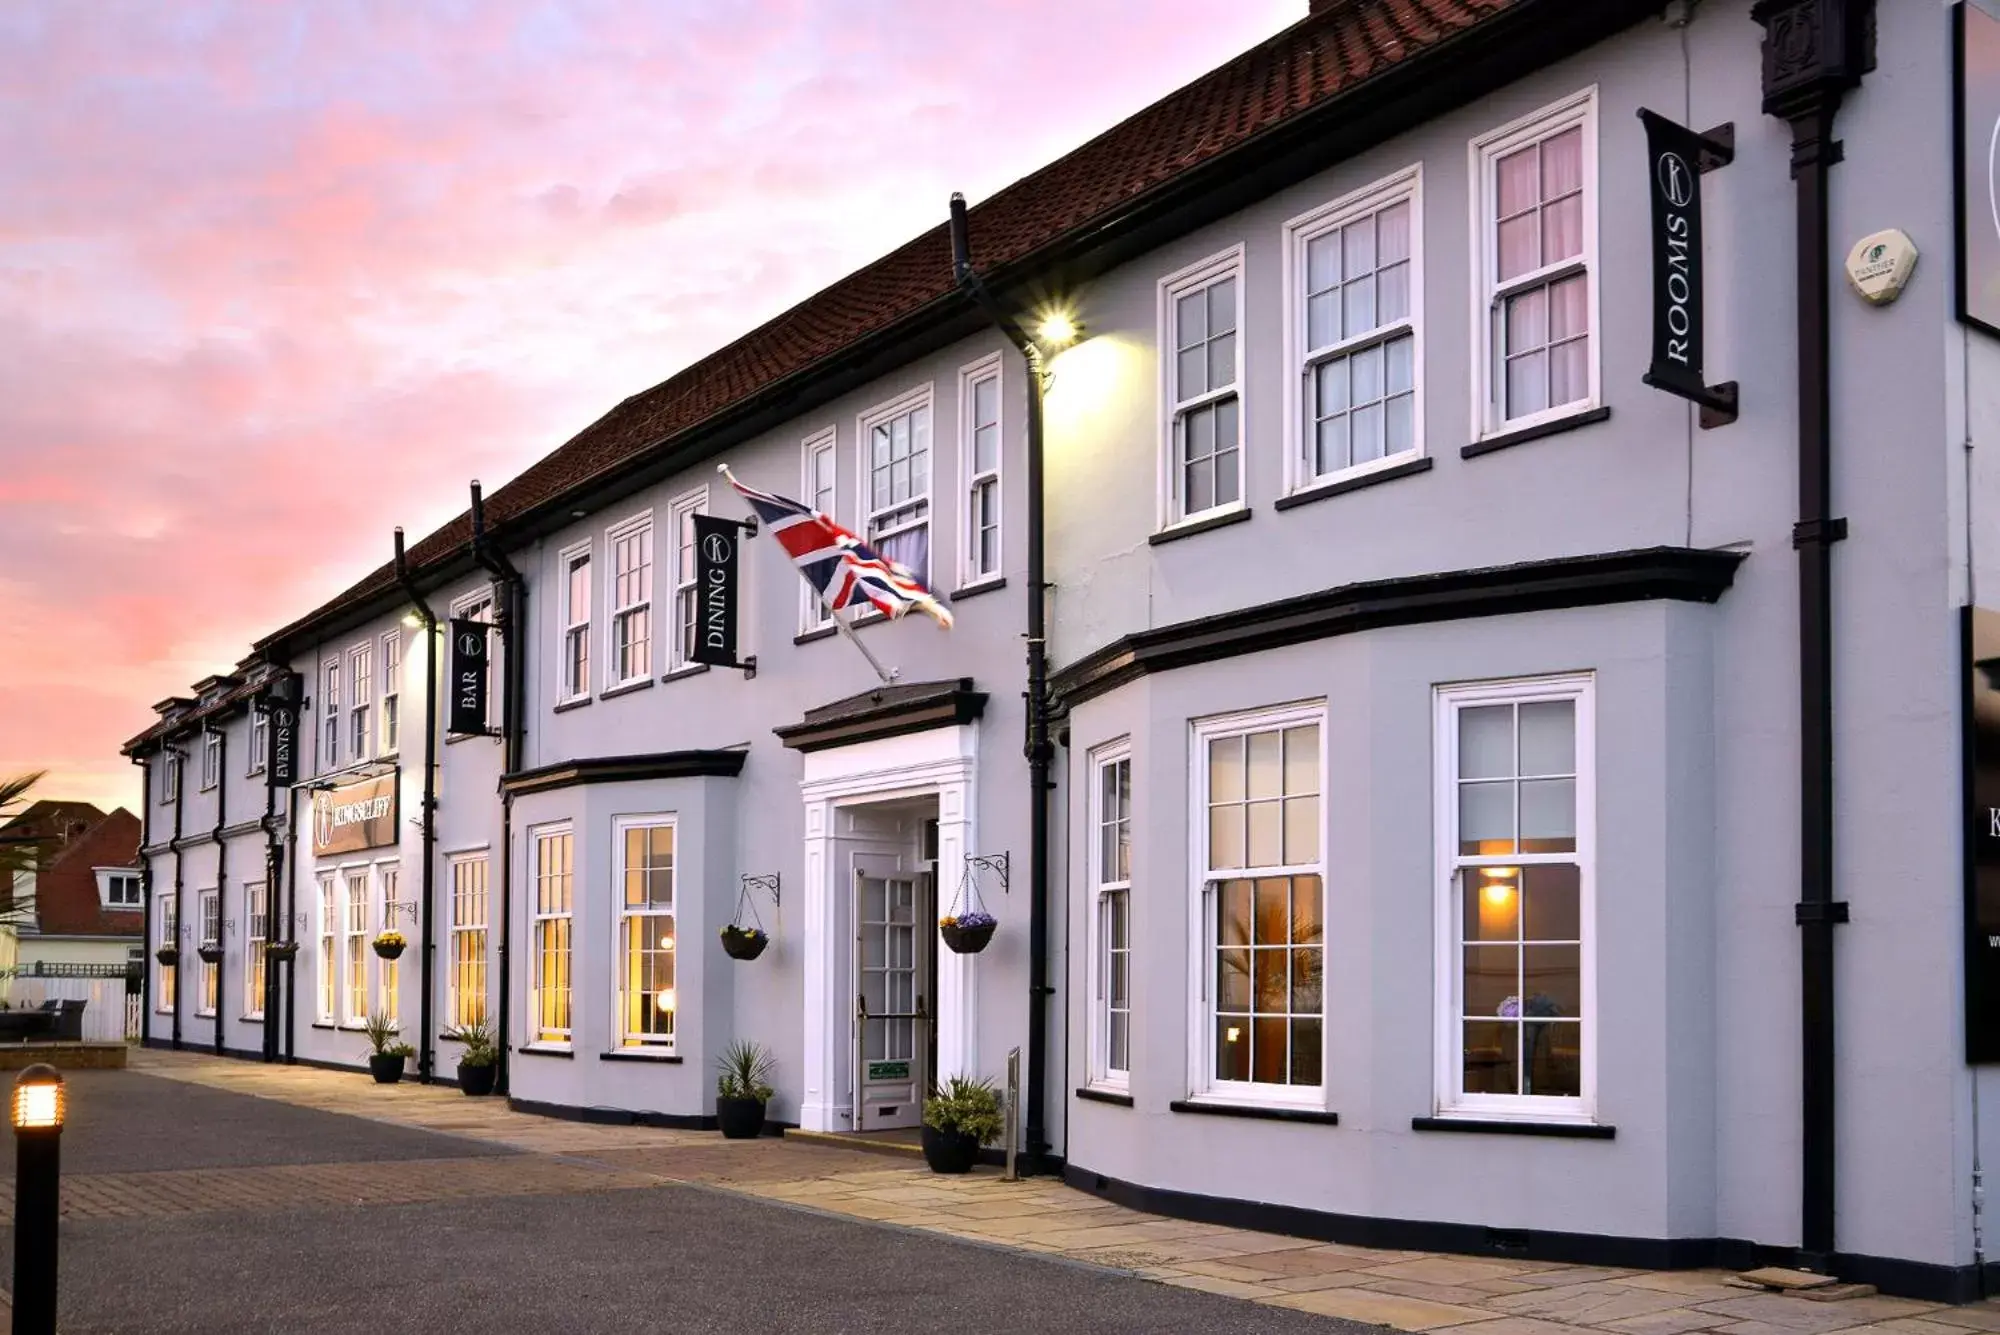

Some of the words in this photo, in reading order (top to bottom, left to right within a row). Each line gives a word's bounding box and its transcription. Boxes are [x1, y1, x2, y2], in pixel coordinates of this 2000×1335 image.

[1666, 214, 1689, 365] ROOMS
[707, 568, 726, 649] DINING
[461, 671, 477, 709] BAR
[276, 727, 290, 778] EVENTS
